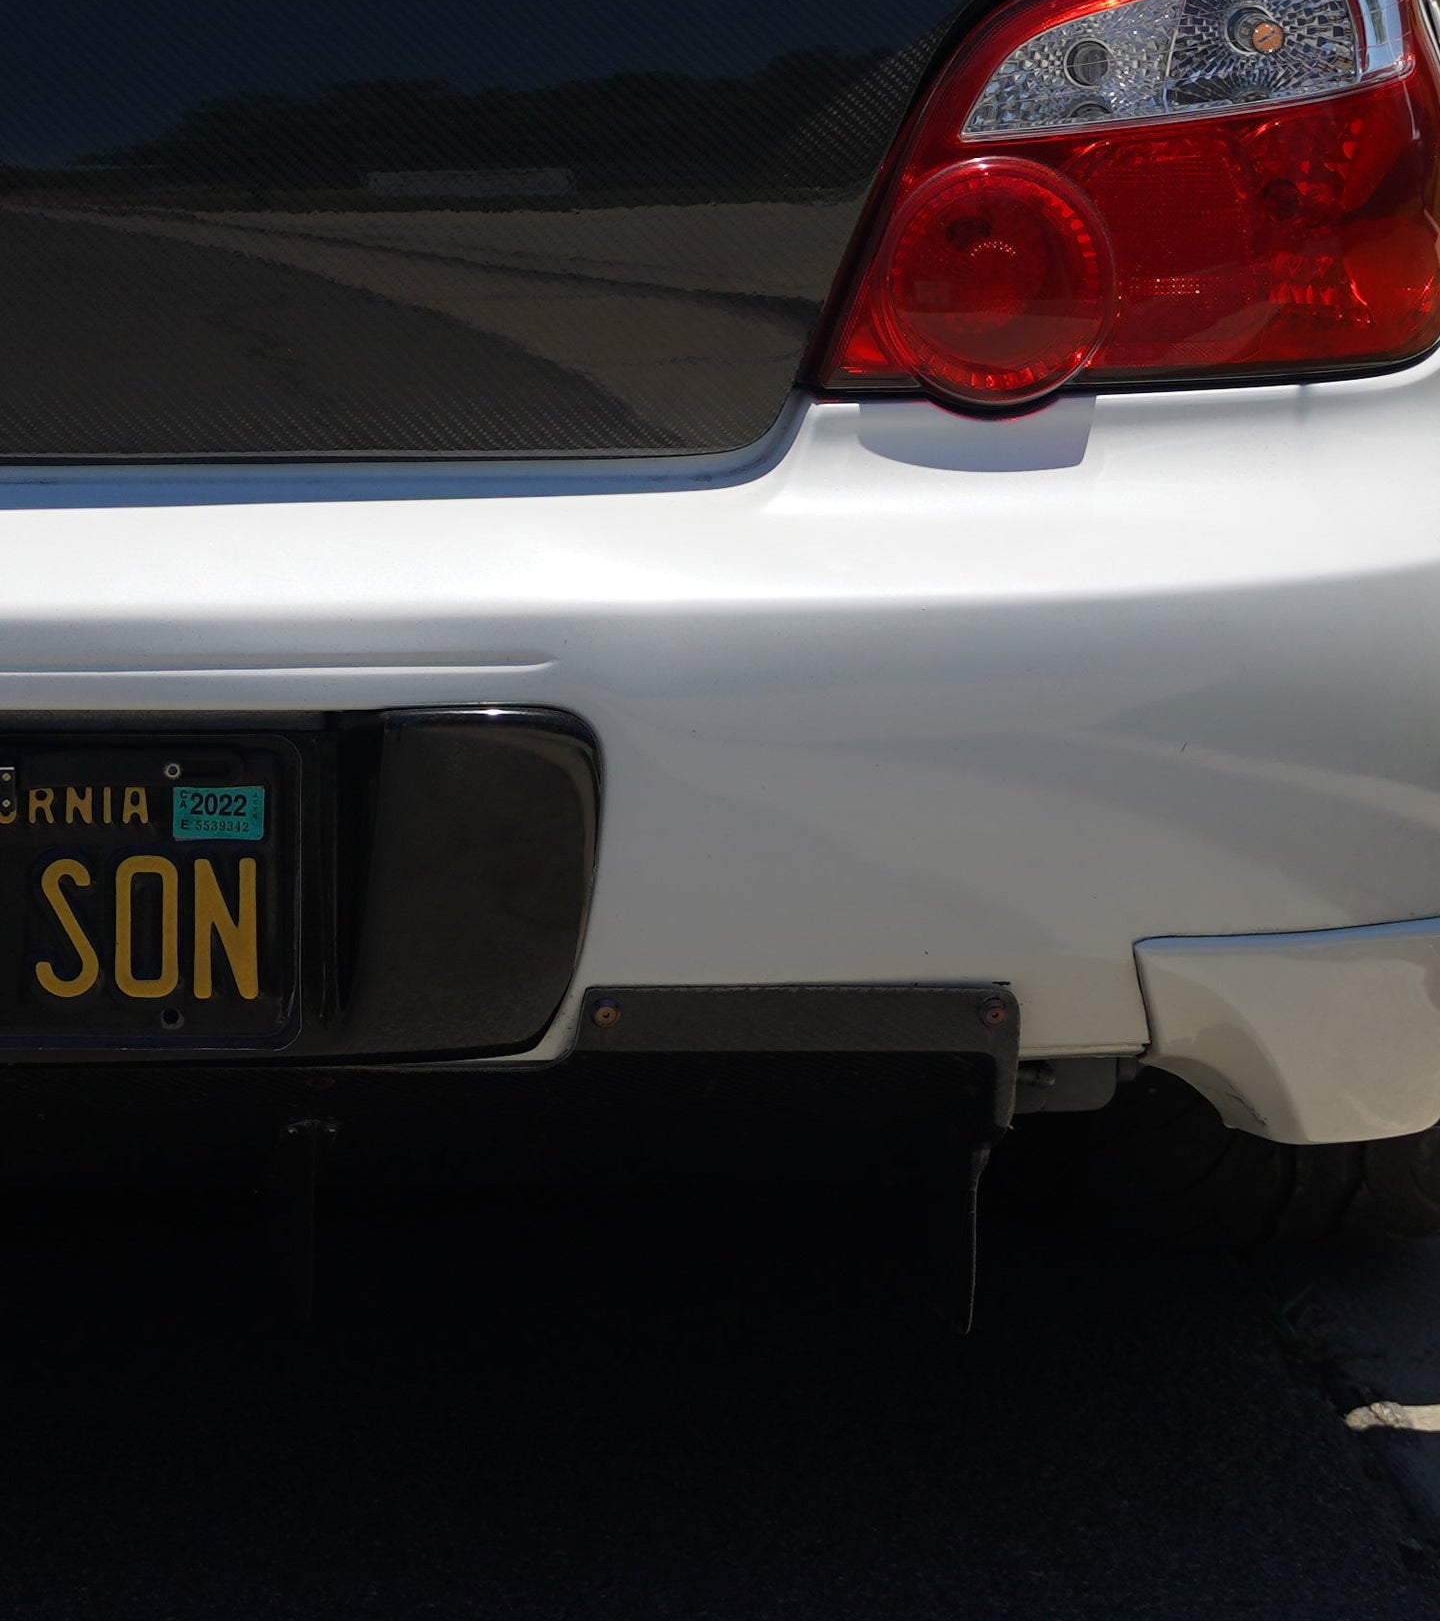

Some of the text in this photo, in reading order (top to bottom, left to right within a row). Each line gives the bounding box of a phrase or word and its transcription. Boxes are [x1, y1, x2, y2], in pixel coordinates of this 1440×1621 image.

[189, 792, 247, 817] 2022
[181, 819, 189, 830] E
[34, 854, 259, 999] SON
